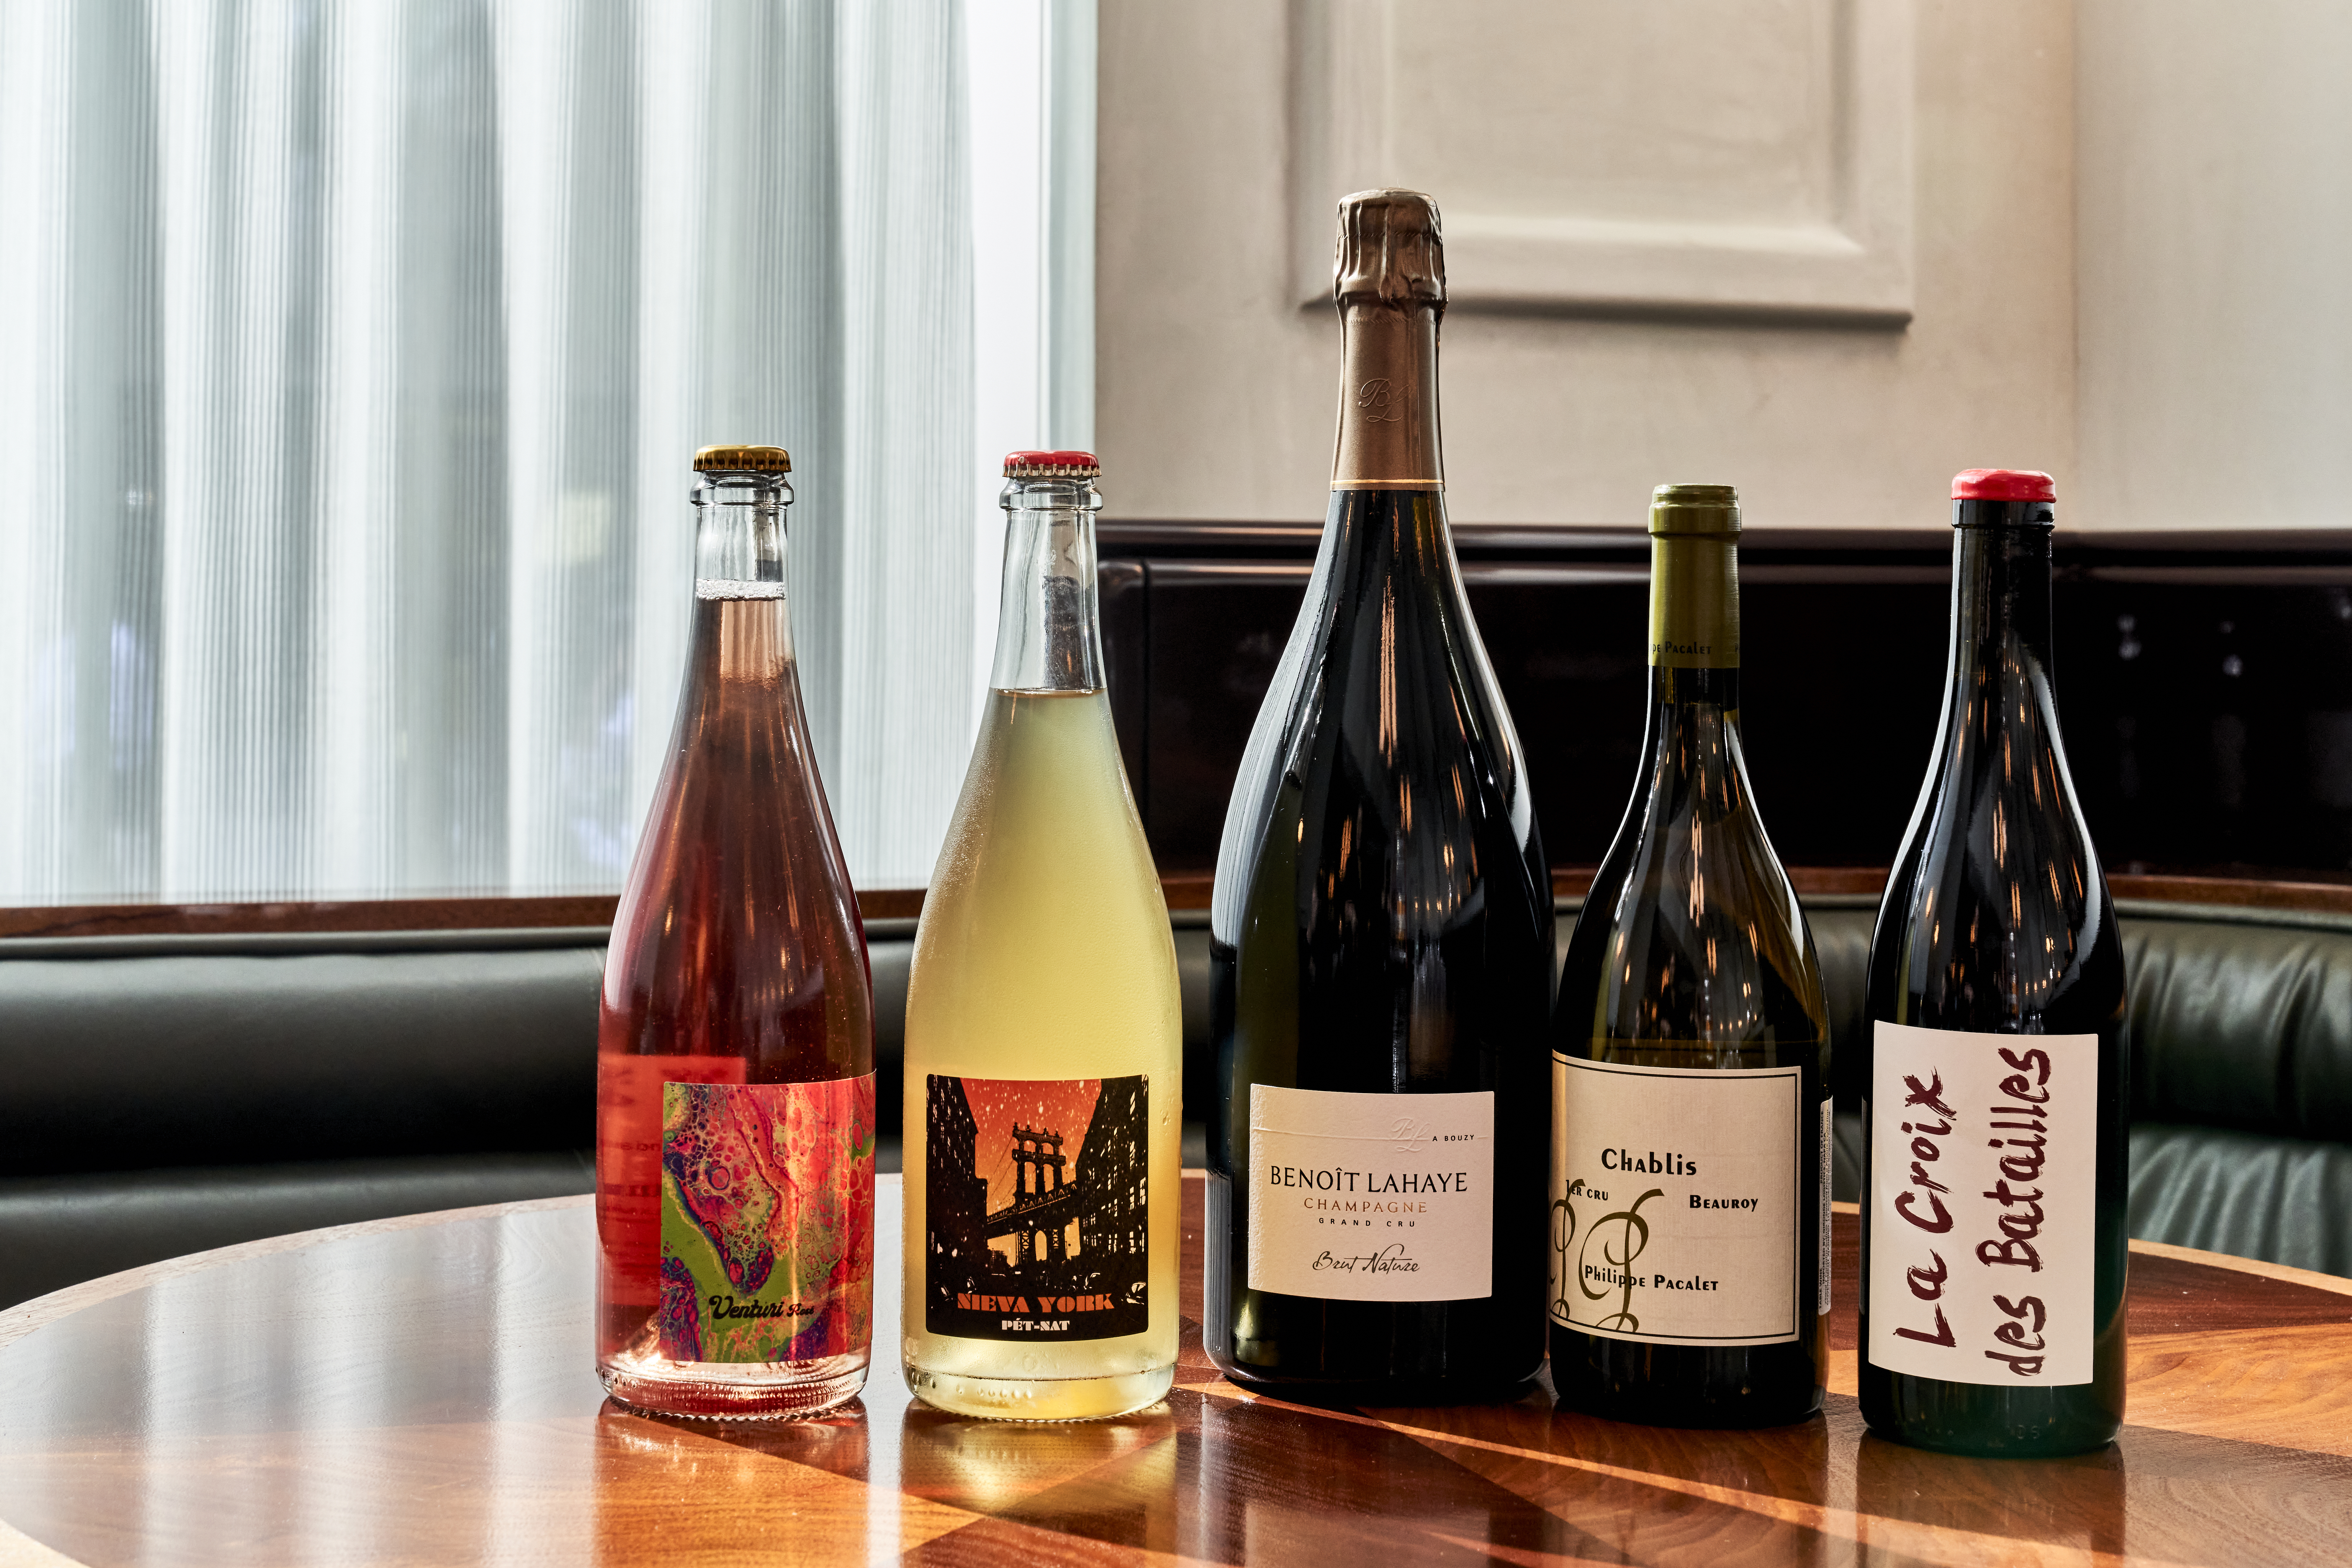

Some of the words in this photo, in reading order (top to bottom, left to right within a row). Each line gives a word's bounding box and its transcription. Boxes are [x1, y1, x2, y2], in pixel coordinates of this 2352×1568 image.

[1895, 1066, 1957, 1234] Croix
[1975, 1048, 2051, 1273] Batailles
[1271, 1165, 1360, 1192] BENOÎT
[1368, 1172, 1467, 1193] LAHAYE
[1304, 1198, 1427, 1213] CHAMPAGNE
[1319, 1218, 1370, 1226] GRAND
[1312, 1250, 1366, 1273] Brut
[1362, 1244, 1420, 1275] Nature
[709, 1295, 785, 1319] Venturi
[787, 1303, 815, 1317] Rosé
[957, 1293, 1030, 1313] NIEVA
[1037, 1293, 1115, 1313] YORK
[1892, 1249, 1957, 1348] La
[1002, 1318, 1070, 1331] PÉT-NAT
[1984, 1295, 2047, 1377] des
